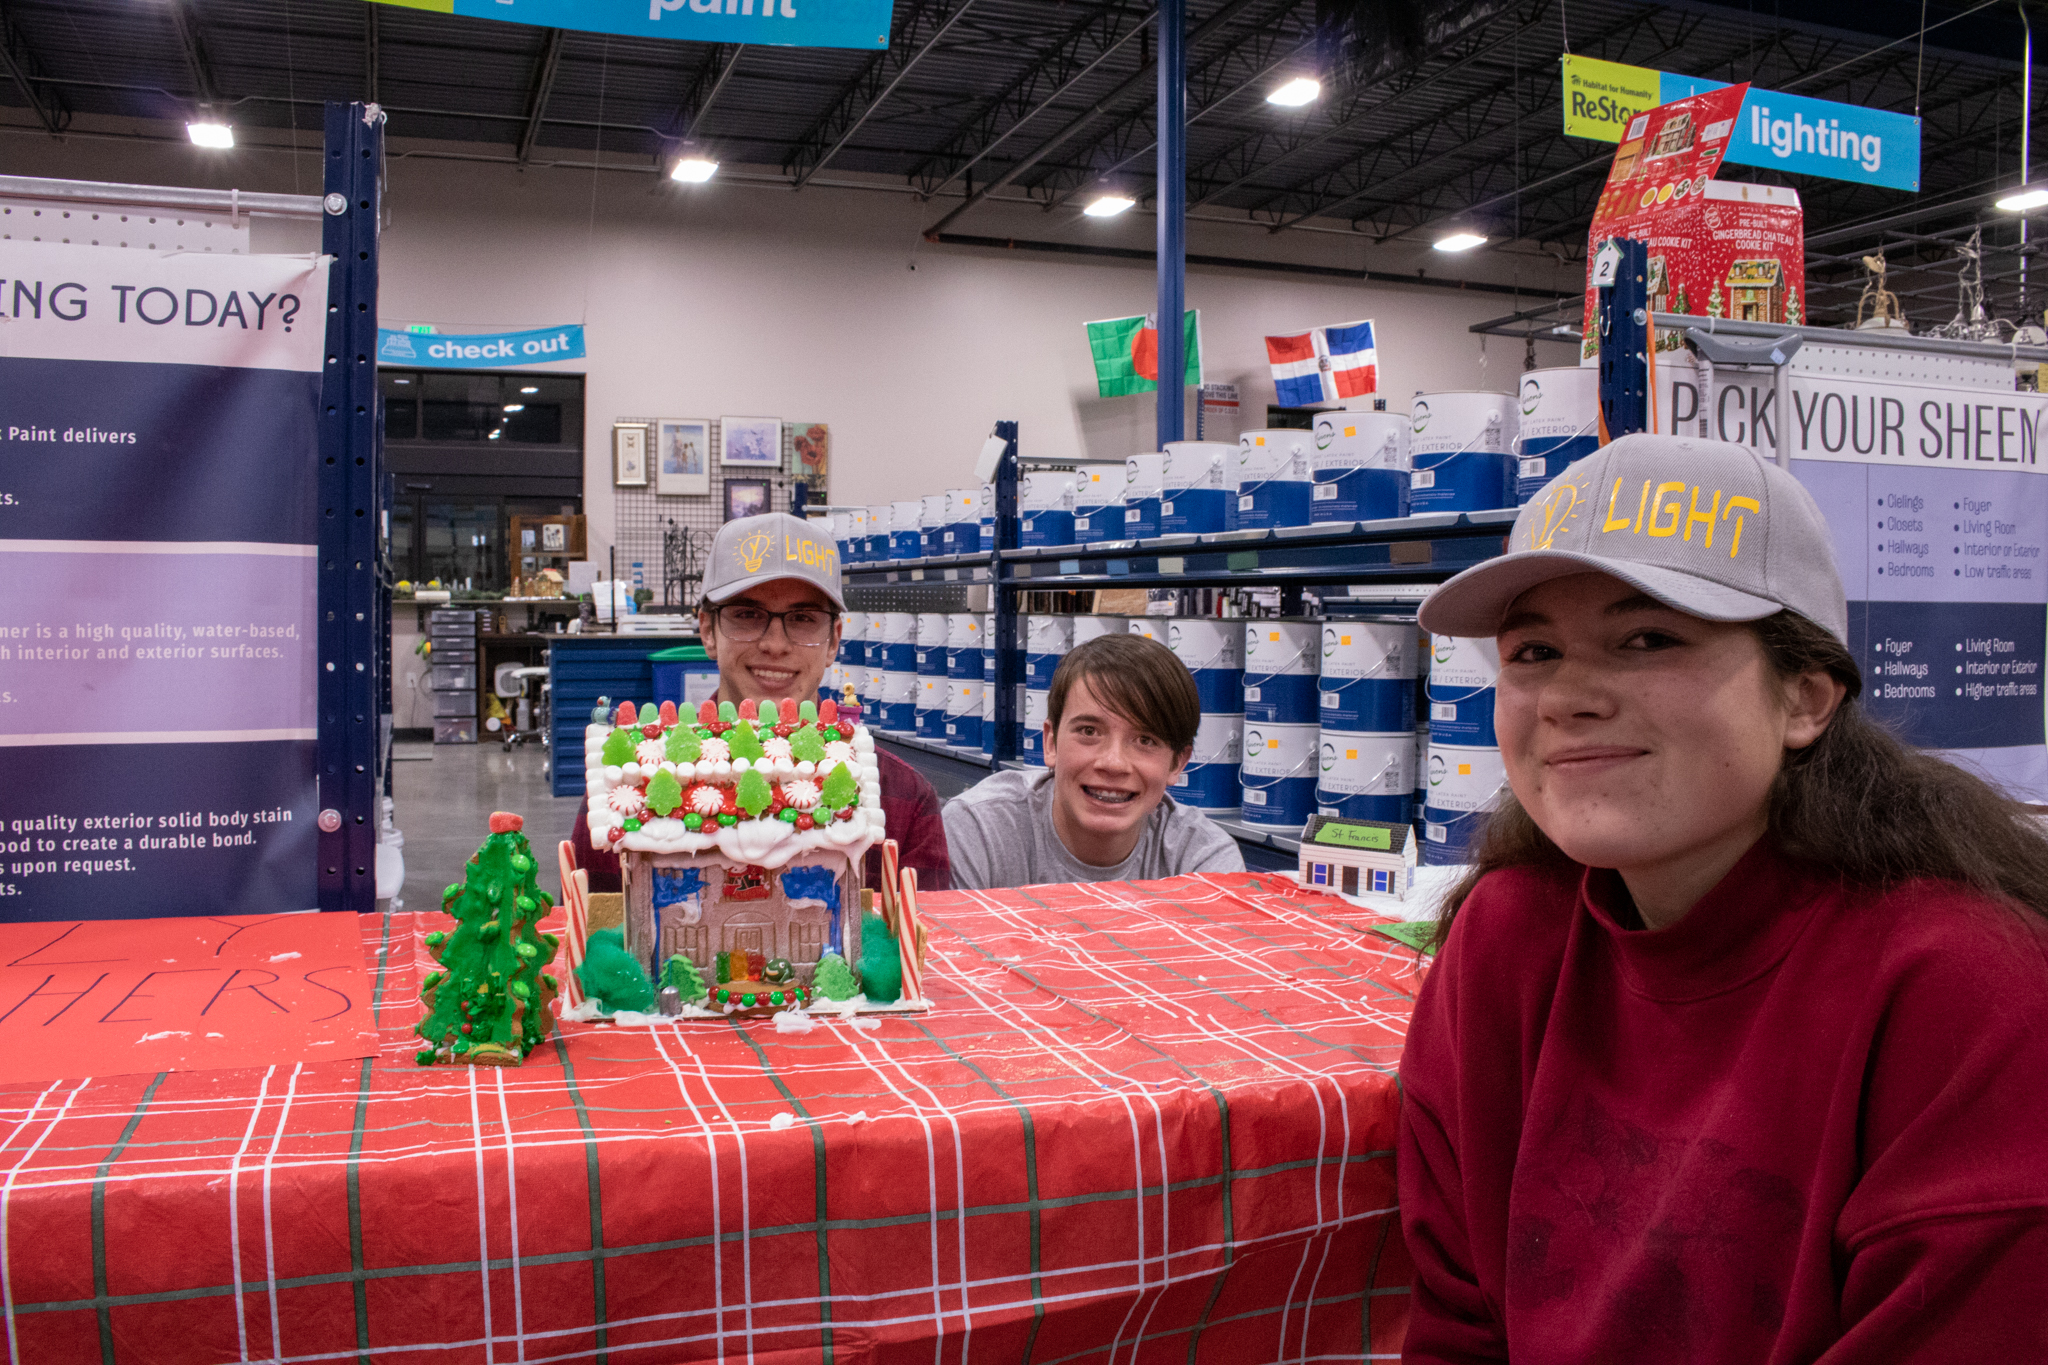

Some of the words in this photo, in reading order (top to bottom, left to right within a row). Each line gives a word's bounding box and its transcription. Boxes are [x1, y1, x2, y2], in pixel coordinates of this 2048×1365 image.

[1583, 80, 1607, 91] Habitat
[1610, 83, 1619, 93] for
[1620, 86, 1652, 100] Humanity
[1751, 105, 1882, 172] lighting
[1740, 218, 1768, 229] PRE-BUILT
[1661, 237, 1680, 248] COOKIE
[1680, 238, 1693, 249] KIT
[1712, 228, 1762, 241] GINGERBREAD
[1763, 230, 1795, 246] CHATEAU
[1735, 239, 1762, 251] COOKIE
[1762, 241, 1774, 252] KIT
[1600, 261, 1610, 277] 2
[111, 284, 301, 333] TODAY?
[428, 340, 516, 359] check
[522, 333, 569, 355] out
[1531, 424, 1578, 436] EXTERIOR
[1671, 381, 1777, 448] PCK
[1792, 389, 1906, 456] YOUR
[1919, 400, 2041, 465] SHEEN
[8, 425, 57, 442] Paint
[63, 427, 137, 444] delivers
[1421, 442, 1463, 452] EXTERIOR
[1325, 459, 1364, 468] EXTERIOR
[1963, 497, 1992, 515] Foyer
[1602, 476, 1760, 559] LIGHT
[1887, 516, 1924, 532] Closets
[1963, 520, 1992, 538] Living
[1994, 520, 2016, 535] Room
[785, 534, 836, 577] LIGHT
[1887, 540, 1929, 558] Hallways
[1963, 542, 2002, 557] Interior
[2003, 547, 2012, 557] or
[2013, 543, 2040, 558] Exterior
[1887, 562, 1935, 578] Bedrooms
[1964, 564, 1984, 578] Low
[1986, 564, 2011, 579] traffic
[2012, 568, 2032, 579] areas
[36, 622, 52, 639] is
[59, 626, 69, 639] a
[76, 622, 115, 642] high
[121, 622, 187, 642] quality,
[192, 622, 300, 641] water-based,
[18, 644, 90, 660] interior
[96, 644, 129, 660] and
[135, 643, 205, 659] exterior
[210, 643, 284, 659] surfaces.
[1885, 638, 1913, 656] Foyer
[1966, 638, 1992, 656] Living
[1993, 638, 2015, 653] Room
[1329, 668, 1366, 677] EXTERIOR
[1884, 661, 1929, 679] Hallways
[1966, 661, 2000, 675] Interior
[2001, 664, 2011, 675] or
[2012, 660, 2038, 675] Exterior
[1444, 676, 1488, 685] EXTERIOR
[1884, 683, 1936, 698] Bedrooms
[1965, 682, 1995, 701] Higher
[1996, 682, 2019, 697] traffic
[2019, 684, 2037, 696] areas
[1255, 767, 1291, 777] EXTERIOR
[1328, 782, 1365, 792] EXTERIOR
[1437, 799, 1478, 809] EXTERIOR
[12, 814, 77, 835] quality
[83, 811, 154, 830] exterior
[158, 811, 202, 828] solid
[208, 810, 248, 828] body
[253, 806, 293, 824] stain
[37, 838, 56, 852] to
[62, 836, 118, 851] create
[123, 837, 133, 850] a
[139, 832, 206, 850] durable
[212, 830, 257, 848] bond.
[1331, 828, 1344, 839] St
[1348, 829, 1379, 843] Francis
[11, 860, 57, 877] upon
[64, 857, 137, 875] request.
